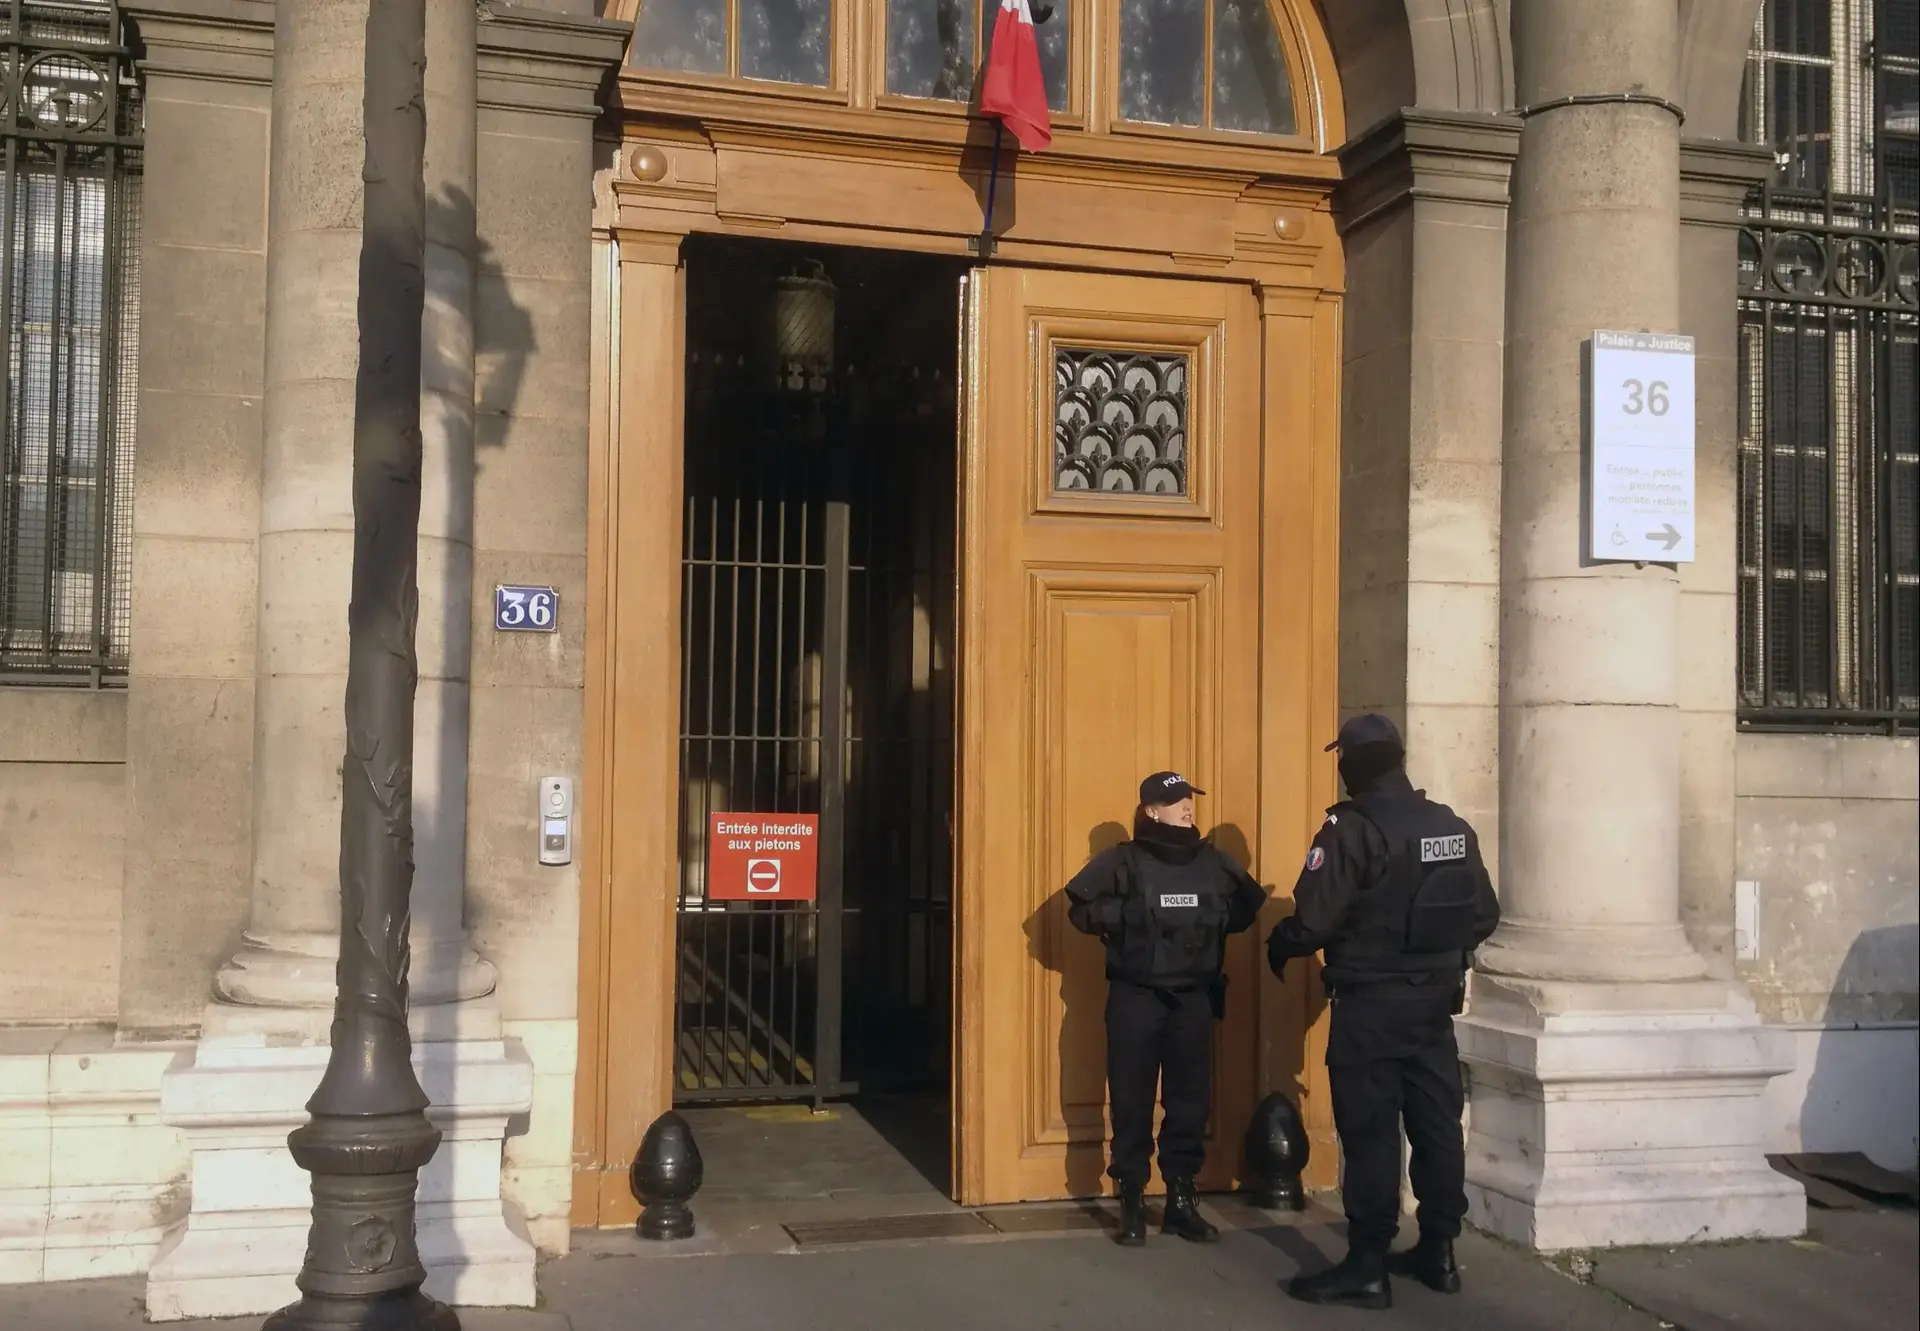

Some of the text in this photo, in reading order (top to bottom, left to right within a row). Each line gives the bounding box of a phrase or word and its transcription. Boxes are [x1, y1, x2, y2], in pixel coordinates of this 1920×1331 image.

[1599, 332, 1634, 347] Palais
[1648, 336, 1692, 351] Justice
[1621, 378, 1670, 417] 36
[500, 592, 551, 626] 36
[717, 821, 813, 836] Entrée interdite
[728, 839, 752, 850] aux
[1424, 838, 1464, 859] POLICE
[1164, 896, 1195, 905] POLICE
